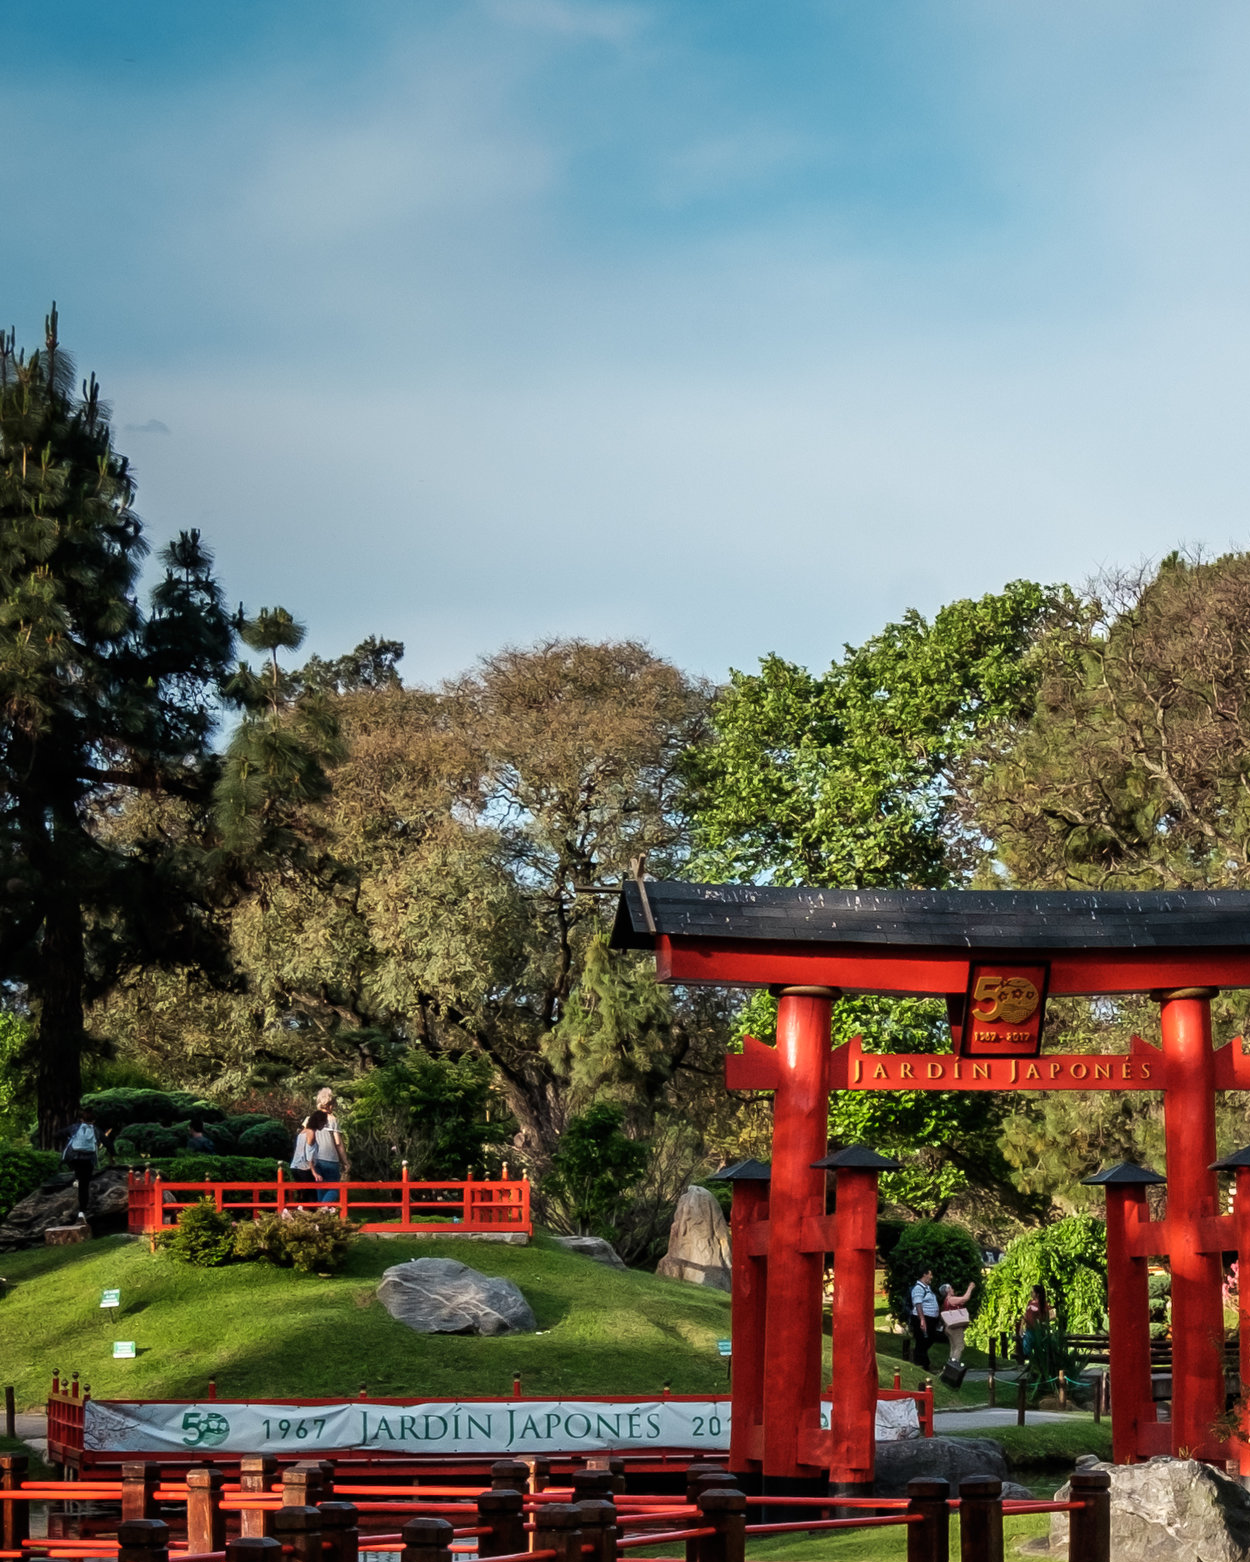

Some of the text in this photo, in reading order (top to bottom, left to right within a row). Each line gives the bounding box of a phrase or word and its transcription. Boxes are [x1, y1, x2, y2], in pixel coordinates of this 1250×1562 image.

[972, 976, 1039, 1023] 50
[853, 1056, 1151, 1083] JARDÍN JAPONÉS
[182, 1412, 230, 1446] 50
[262, 1418, 326, 1440] 1967
[360, 1407, 492, 1446] JARDÍN
[505, 1407, 661, 1448] JAPONÉS
